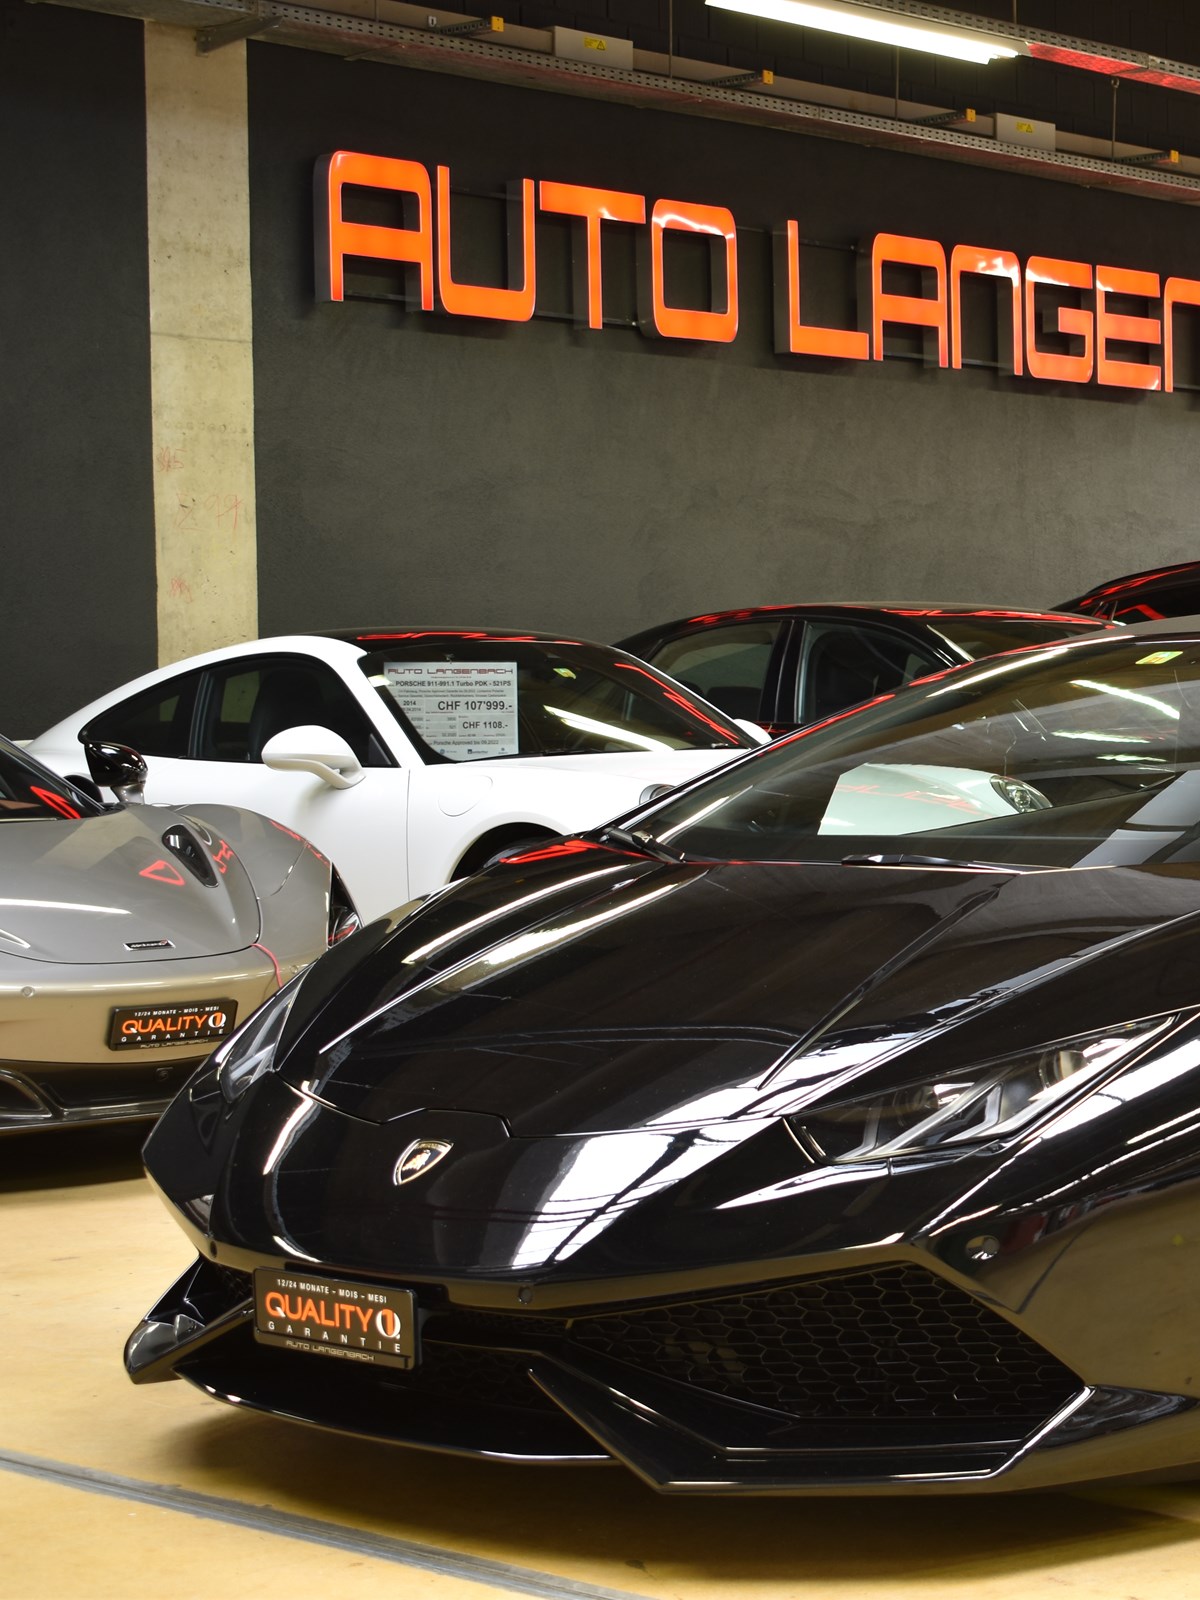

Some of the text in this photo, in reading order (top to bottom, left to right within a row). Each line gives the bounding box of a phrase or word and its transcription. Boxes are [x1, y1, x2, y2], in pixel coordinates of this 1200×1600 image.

[328, 150, 739, 343] AUTO
[437, 700, 513, 711] CHF 107'999.-
[462, 721, 508, 729] CHF 1108.-
[152, 1008, 177, 1016] MONATE
[121, 1014, 208, 1034] QUALITY
[121, 1028, 224, 1043] GARANTIE
[276, 1278, 297, 1289] 12/24
[299, 1282, 330, 1295] MONATE
[339, 1288, 359, 1299] MOIS
[367, 1293, 387, 1304] MESI
[264, 1291, 374, 1333] QUALITY
[268, 1320, 401, 1353] GARANTIE
[286, 1340, 375, 1362] AUTO LANGENBACH
